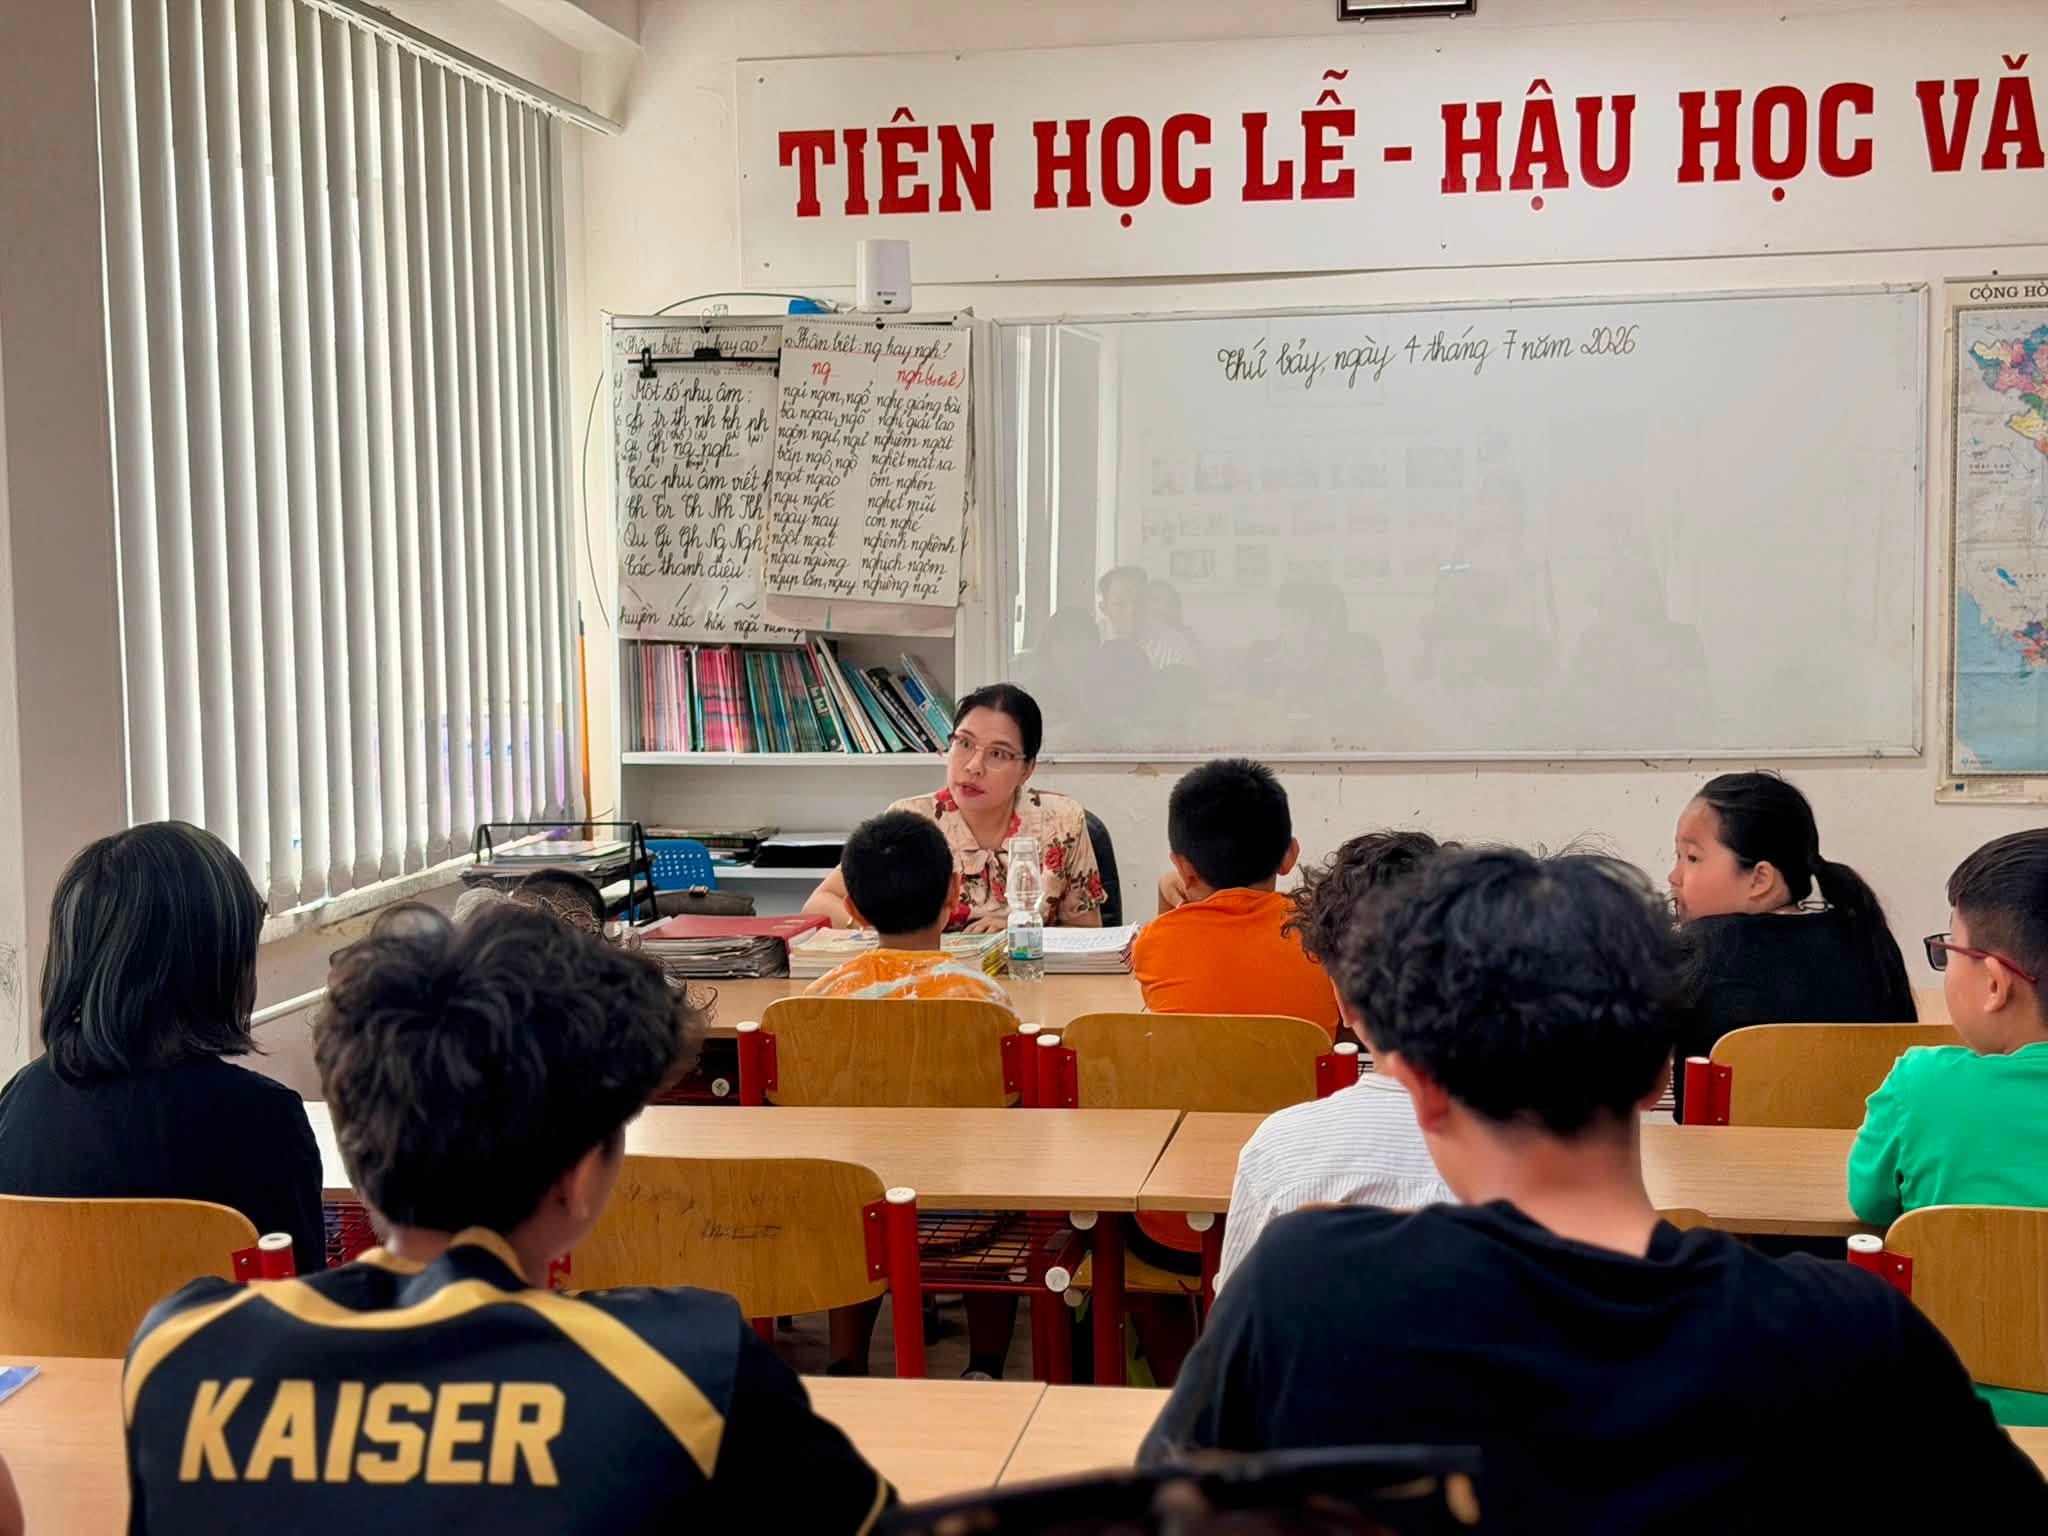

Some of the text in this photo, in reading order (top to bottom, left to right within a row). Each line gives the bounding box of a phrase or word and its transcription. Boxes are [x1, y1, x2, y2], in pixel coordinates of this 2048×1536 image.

[778, 106, 994, 218] TIÊN
[1032, 113, 1212, 228] HỌC
[1241, 68, 1356, 202] LỄ
[1384, 146, 1412, 162] -
[1440, 78, 1636, 211] HẬU
[1677, 82, 1874, 202] HỌC
[1969, 280, 2048, 302] CỘNG HÒ
[863, 340, 882, 363] ng
[886, 336, 912, 364] hay
[1217, 323, 1640, 389] Thứ bảy, ngày 4 tháng 7 năm 2026
[811, 360, 832, 385] ng
[663, 378, 684, 401] số
[695, 406, 717, 430] nh
[720, 405, 742, 431] kh
[744, 408, 770, 441] ph
[934, 410, 956, 431] lao
[697, 469, 730, 492] âm
[773, 506, 841, 538] ngày nay
[865, 513, 888, 529] con
[623, 521, 650, 549] Qu
[659, 551, 706, 578] thanh
[179, 1378, 566, 1487] KAISER
